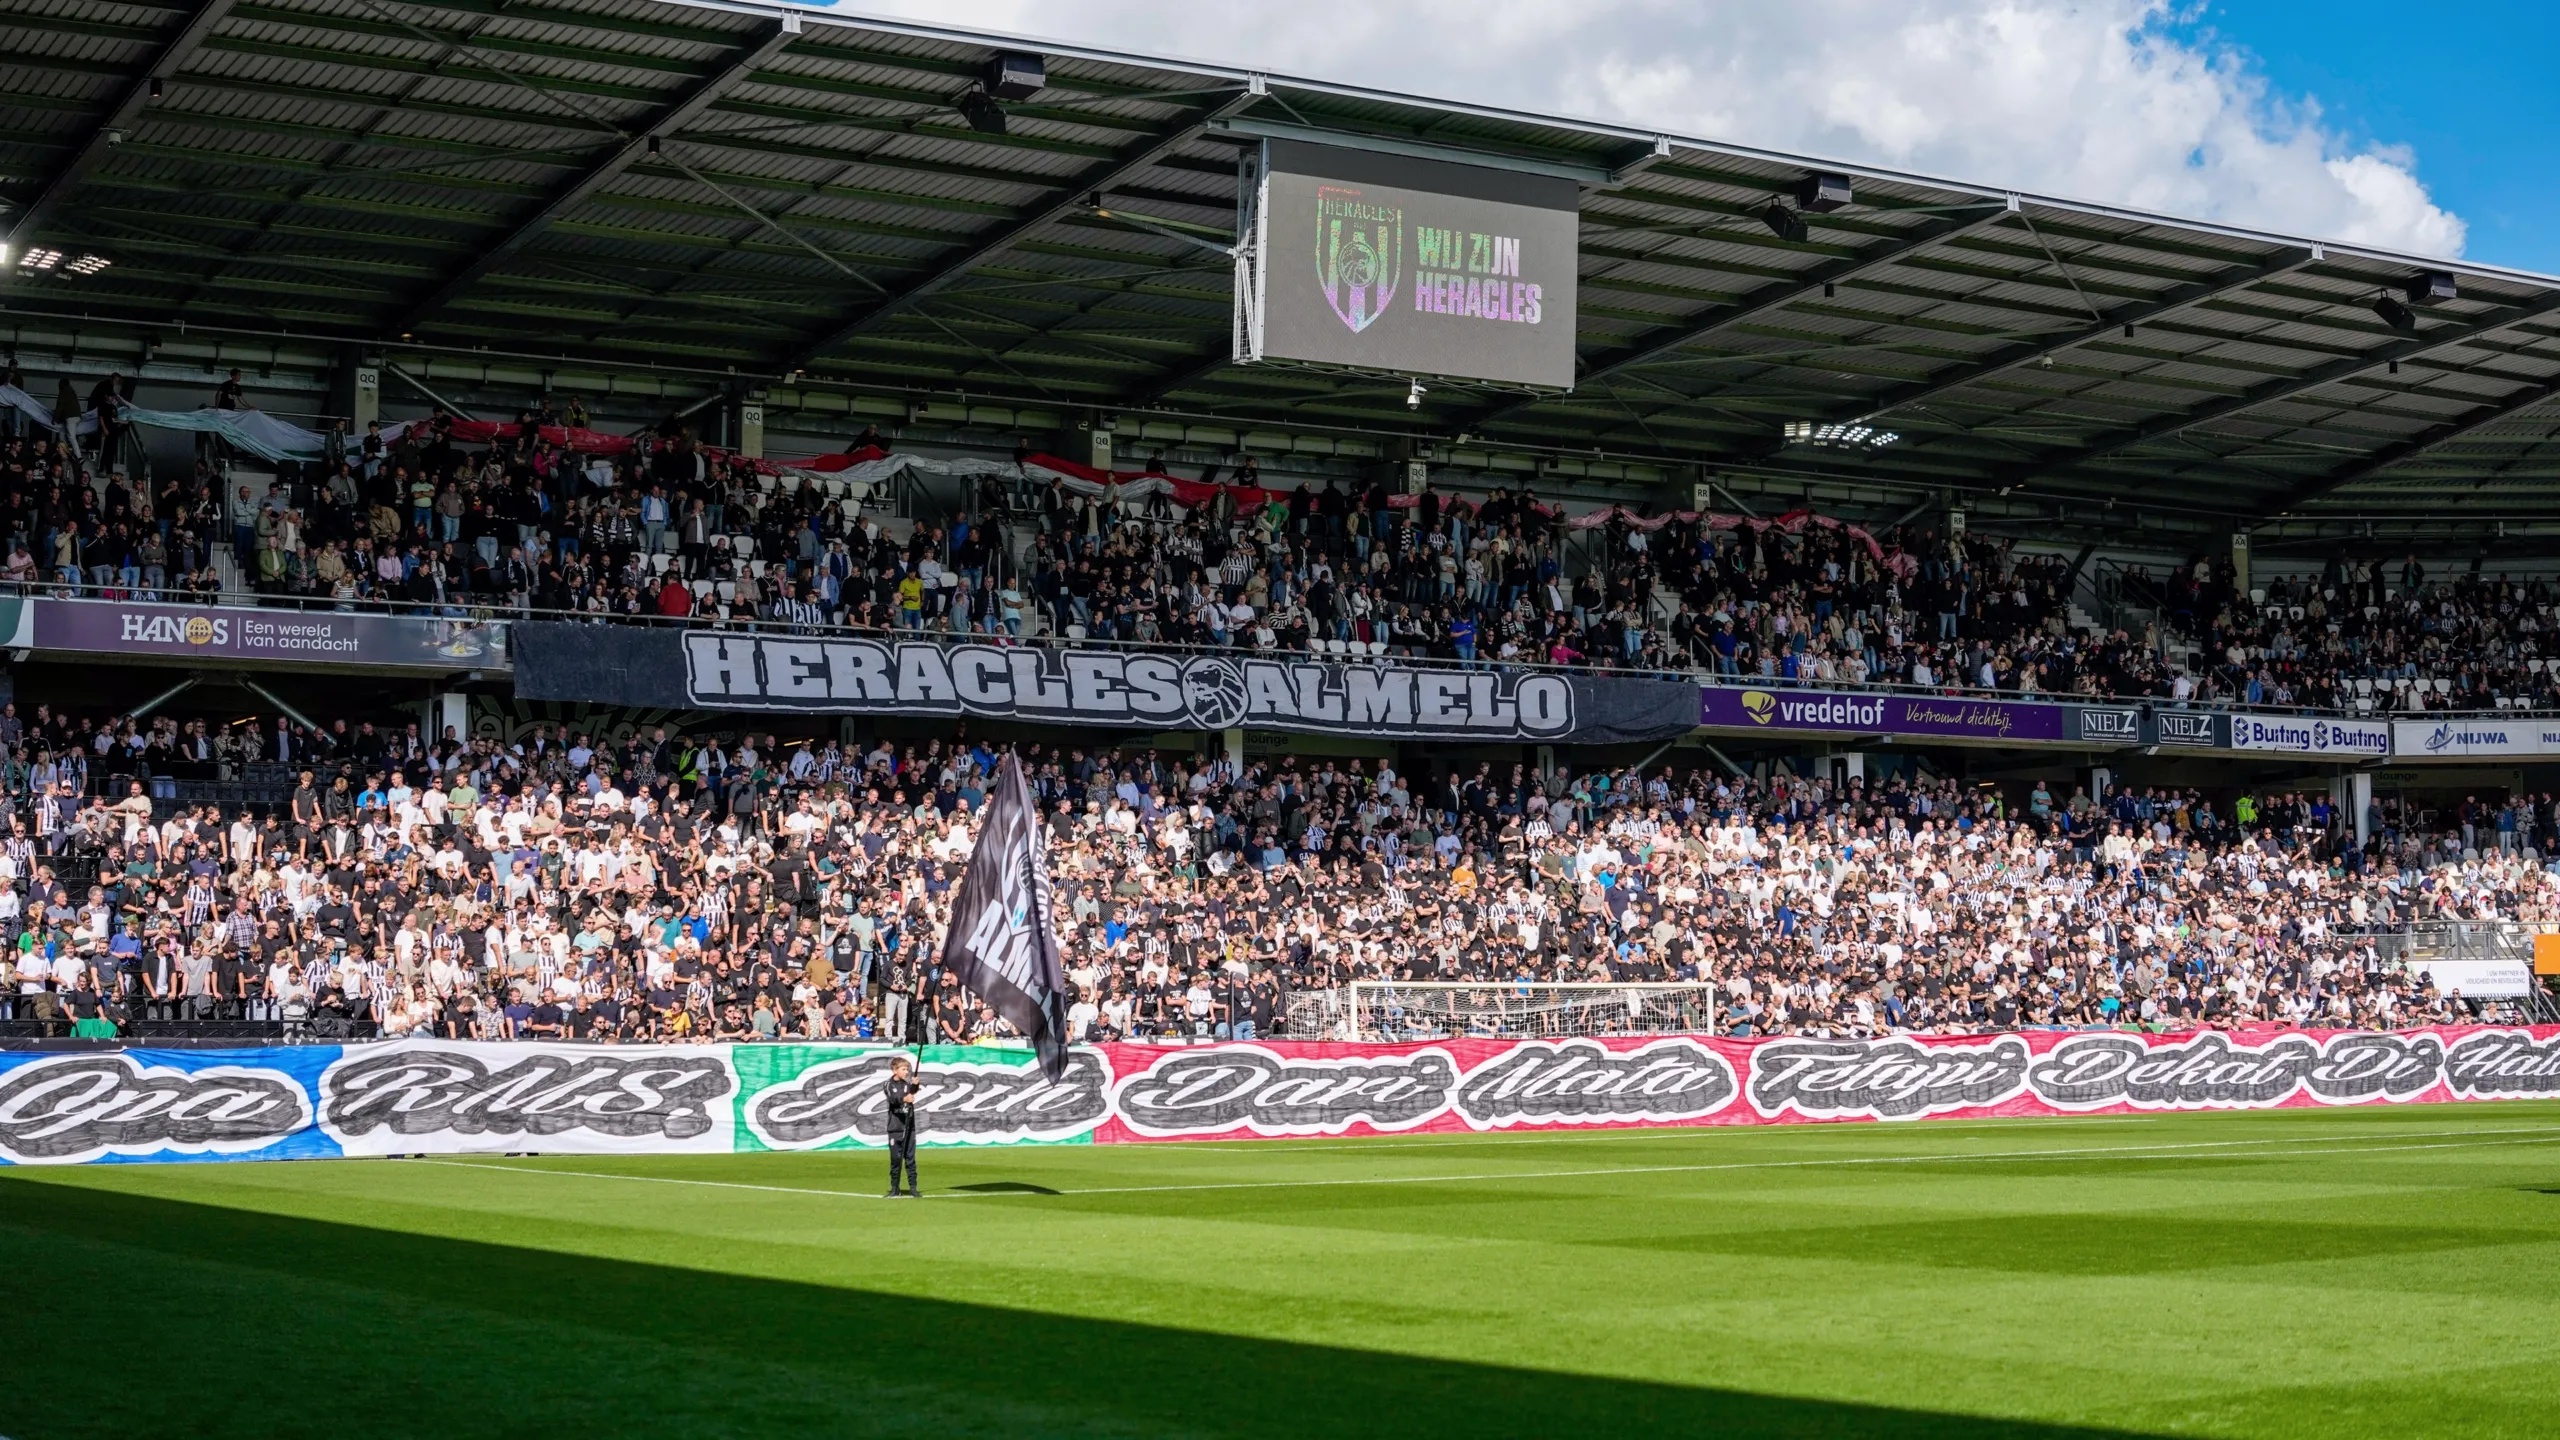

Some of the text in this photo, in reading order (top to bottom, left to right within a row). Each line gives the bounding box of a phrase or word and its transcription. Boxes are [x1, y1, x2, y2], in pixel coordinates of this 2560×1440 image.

[1417, 226, 1520, 277] WIJ ZIJN
[1415, 271, 1542, 324] HERACLES
[360, 373, 376, 384] QQ
[1095, 436, 1108, 446] QQ
[1697, 489, 1708, 497] RR
[1953, 516, 1963, 525] RR
[121, 614, 229, 645] HANOS
[245, 620, 331, 638] Een wereld
[245, 634, 359, 651] van aandacht
[685, 633, 1567, 731] HERACLES ALMELO
[1781, 697, 1884, 725] vredehof
[1906, 703, 2012, 737] Vertrouwd dichtbij.
[2084, 711, 2135, 733] NIELZ
[2161, 715, 2211, 737] NIELZ
[2253, 722, 2310, 749] Buiting
[2332, 727, 2387, 753] Buiting
[2456, 732, 2508, 745] NIJWA
[2513, 771, 2519, 779] 5
[1125, 1059, 1447, 1118] Dari
[1463, 1050, 1724, 1110] Mata
[1757, 1047, 2021, 1108] Tetapi
[2034, 1041, 2314, 1093] Dekat
[2308, 1041, 2438, 1088] Di
